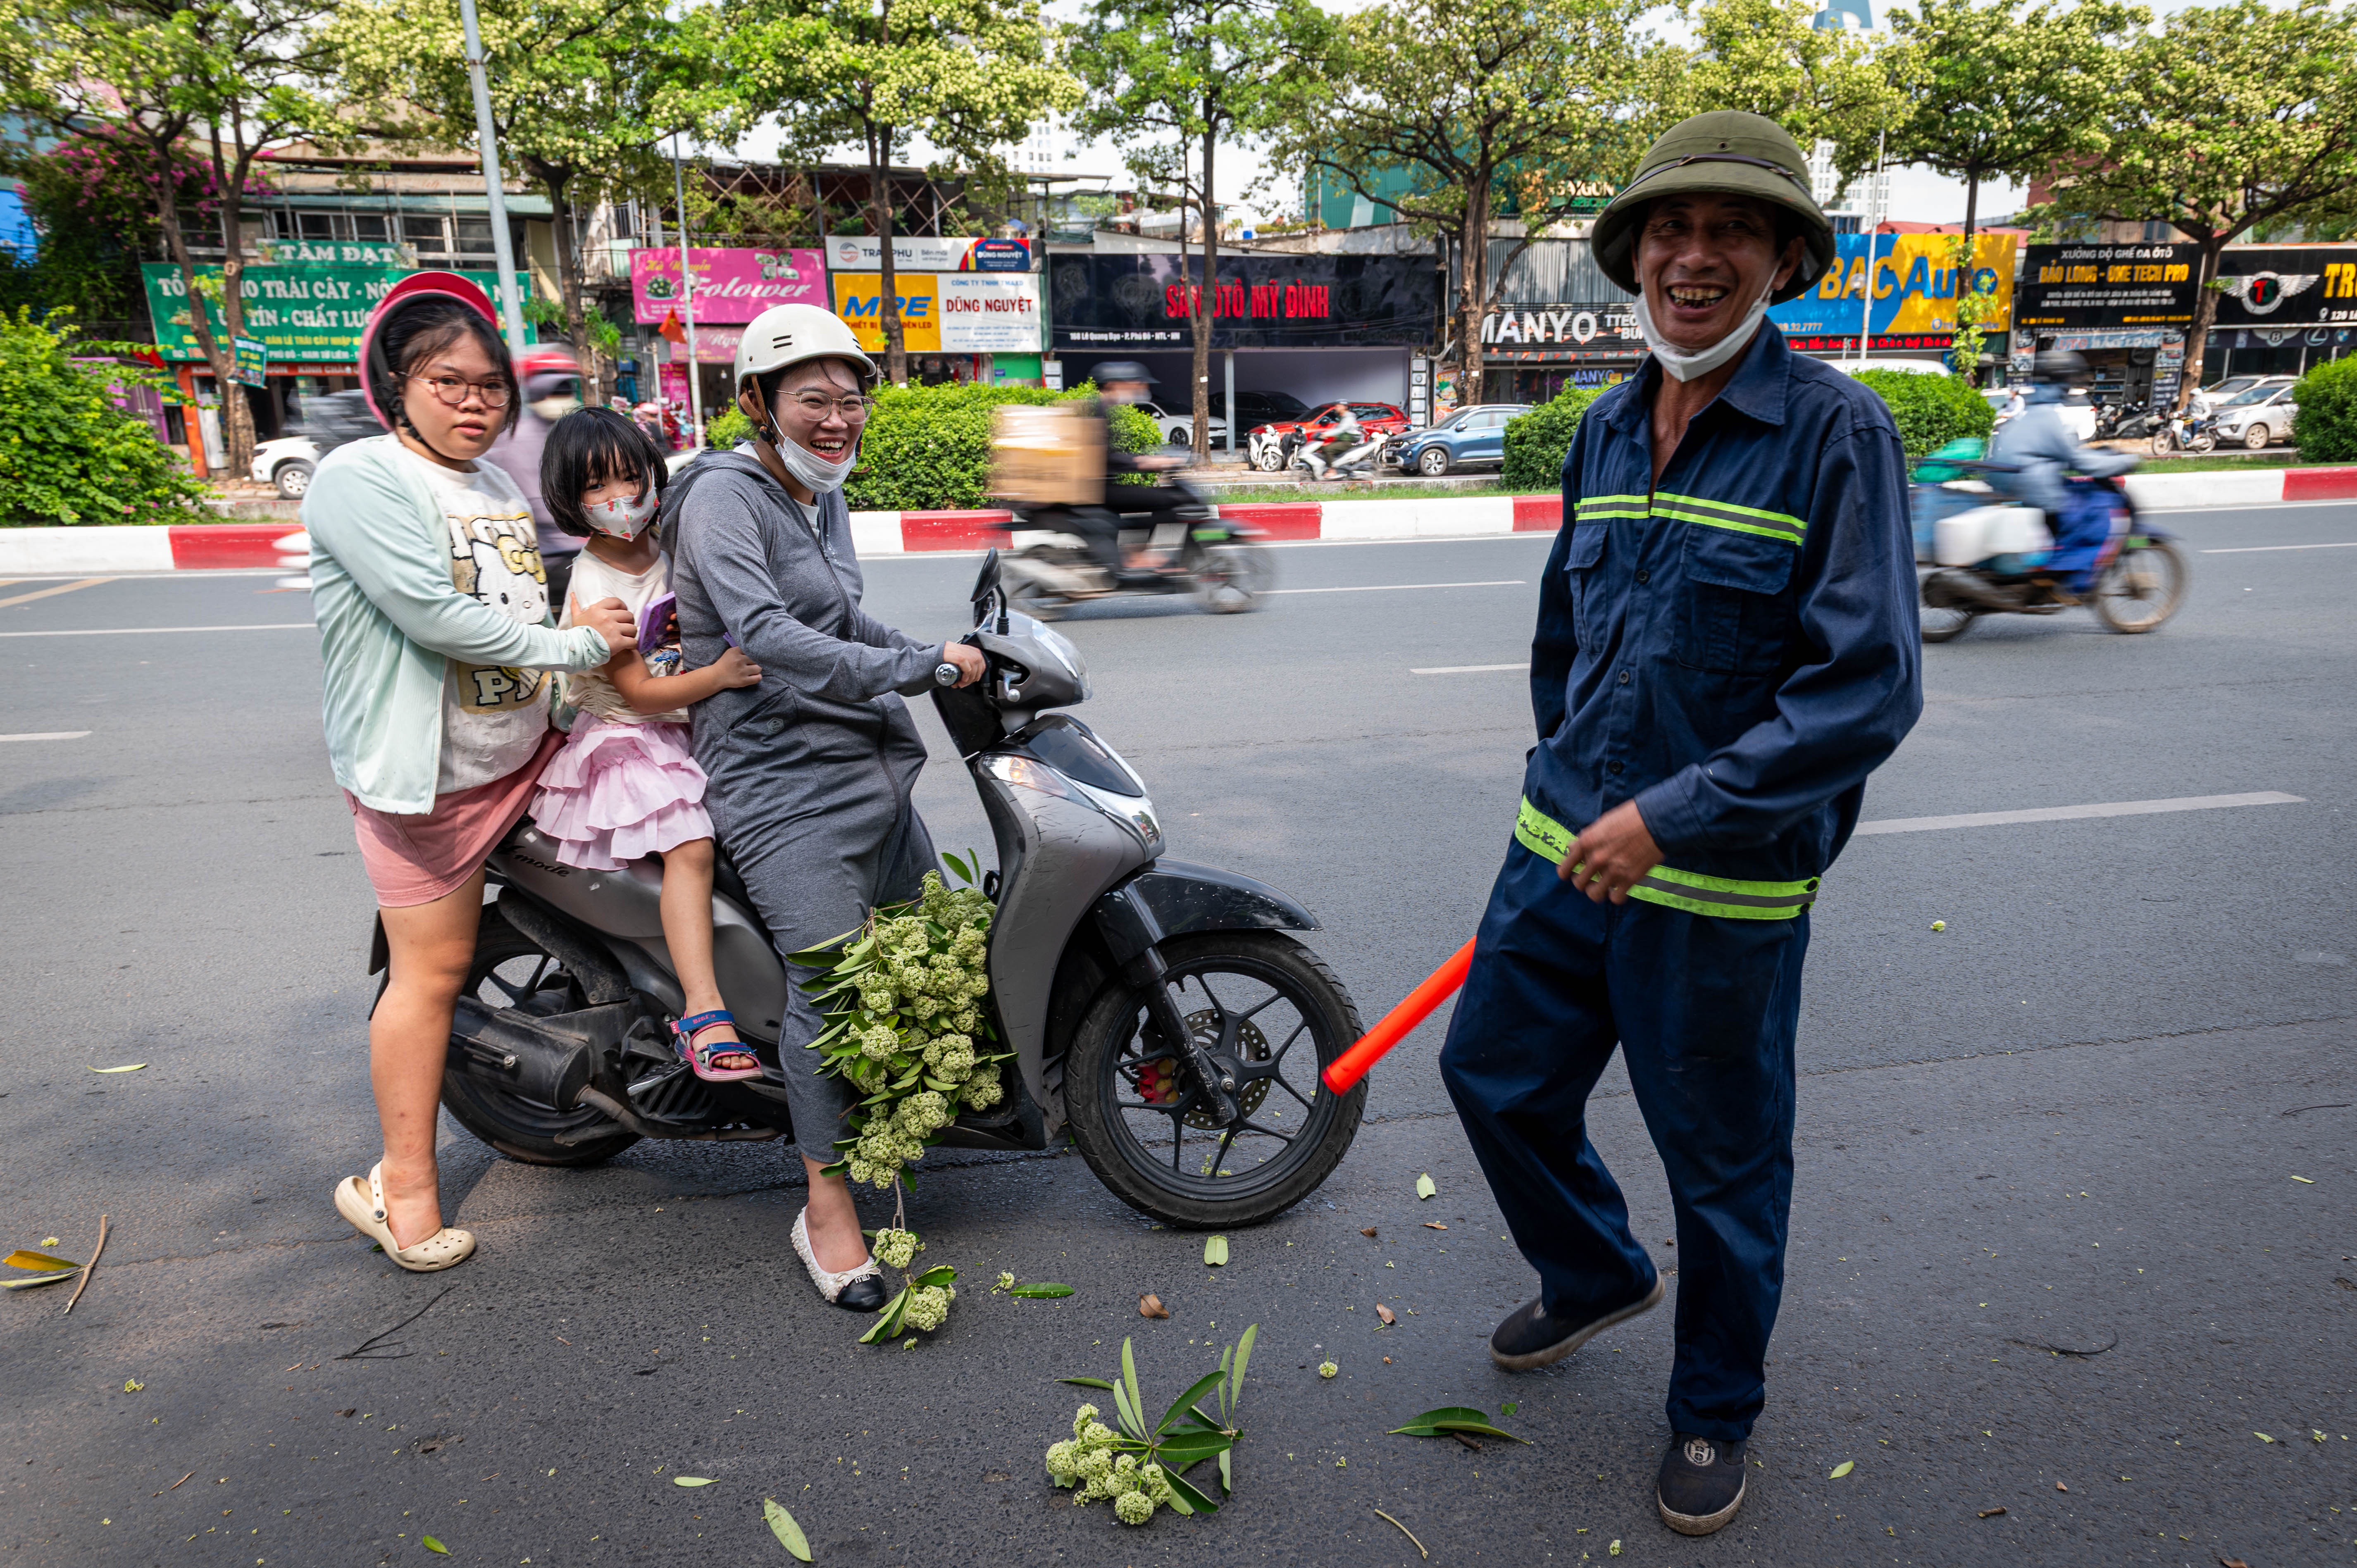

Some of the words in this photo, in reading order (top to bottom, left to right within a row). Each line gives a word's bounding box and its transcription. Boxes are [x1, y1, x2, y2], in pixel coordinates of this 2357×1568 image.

[279, 242, 336, 261] TÂM
[341, 247, 395, 266] ĐẠT
[2039, 260, 2064, 283] BẢO
[2065, 265, 2098, 283] LONG
[2133, 265, 2164, 282] TECH
[2164, 264, 2190, 281] PRO
[2324, 263, 2357, 298] TR
[261, 276, 310, 298] TRÁI
[312, 276, 351, 299] CÂY
[364, 277, 398, 300] NÔ
[1251, 279, 1280, 318] MỸ
[1285, 279, 1329, 318] ĐÌNH
[291, 303, 338, 328] CHẤT
[946, 295, 980, 312] DŨNG
[985, 296, 1032, 315] NGUYỆT
[2330, 310, 2347, 320] 120
[513, 854, 570, 877] mode
